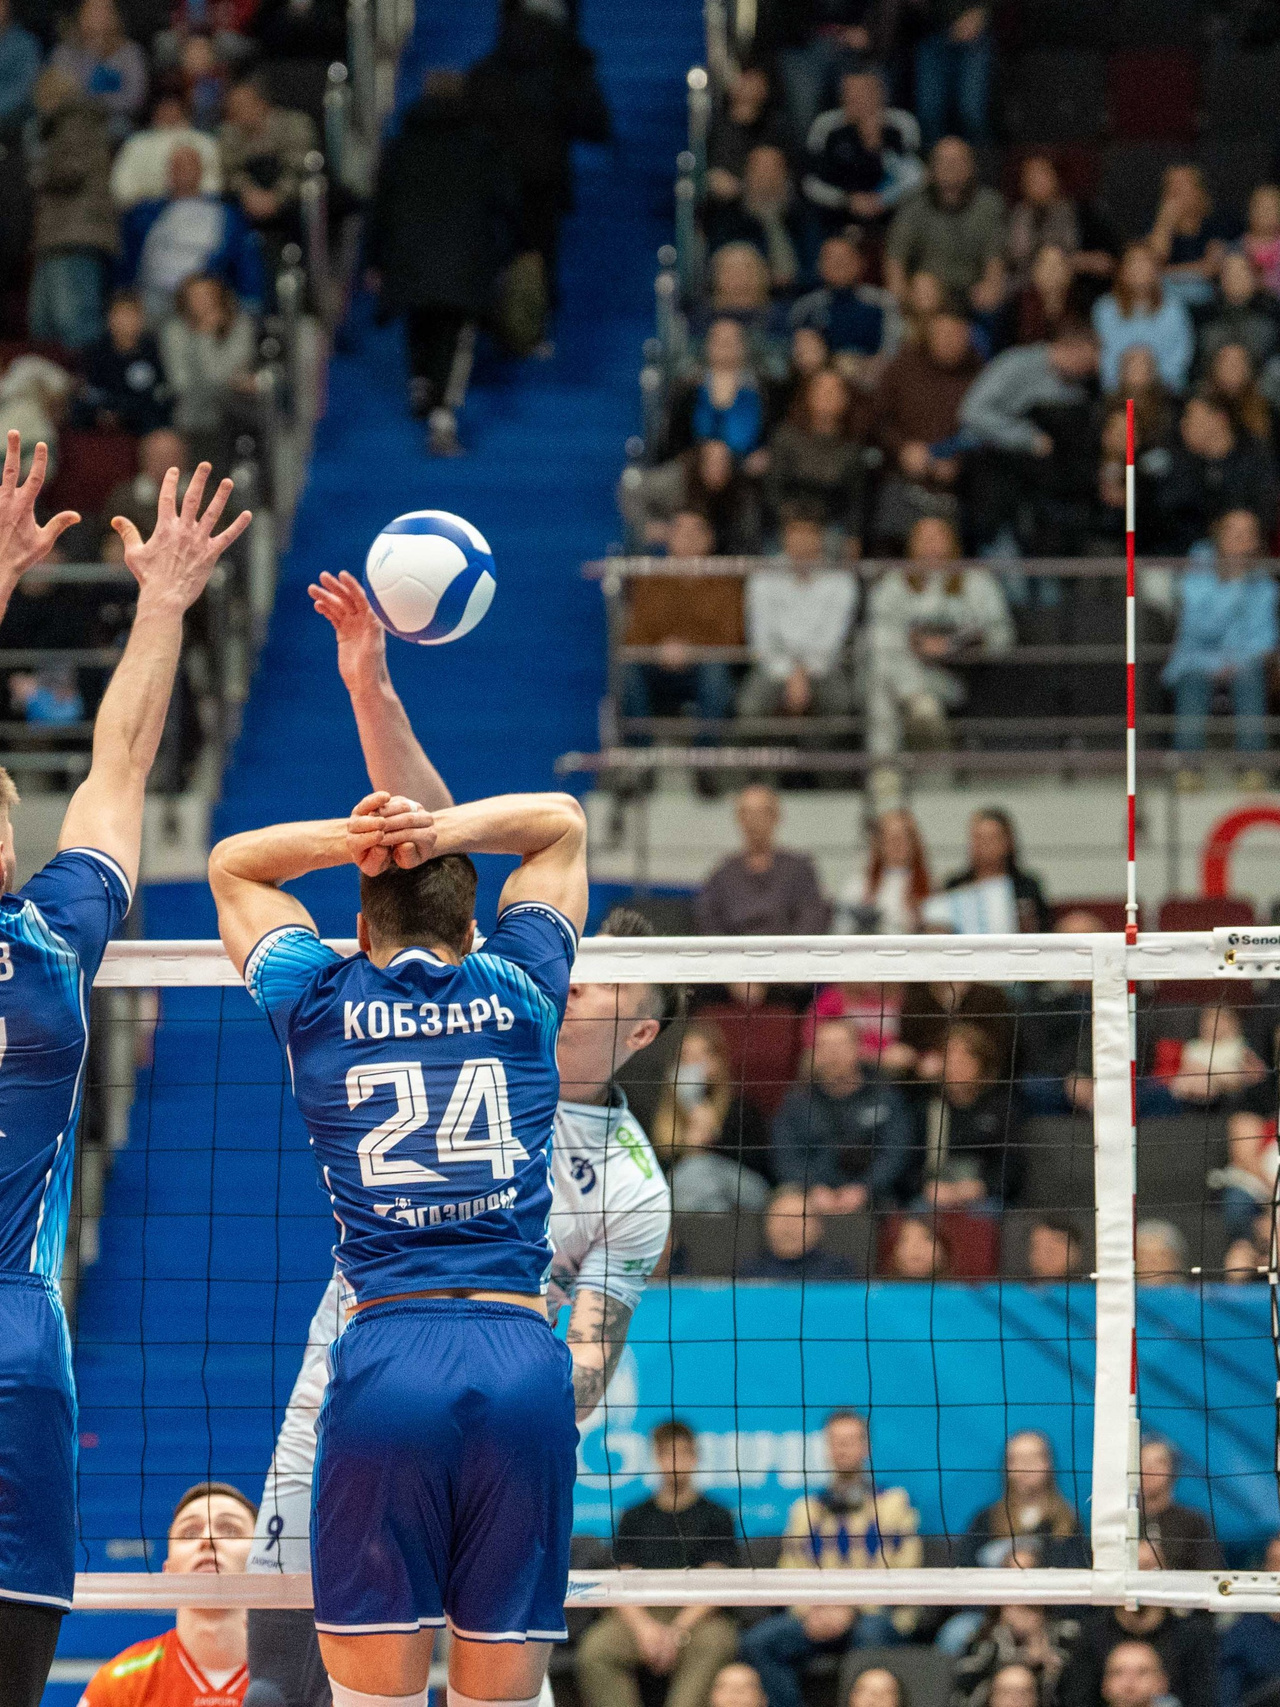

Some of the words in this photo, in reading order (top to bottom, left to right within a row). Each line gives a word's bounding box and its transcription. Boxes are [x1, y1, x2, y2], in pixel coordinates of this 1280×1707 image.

[1241, 934, 1280, 945] Seno
[343, 994, 515, 1040] КОБЗАРЬ
[345, 1057, 530, 1187] 24
[265, 1515, 284, 1551] 9
